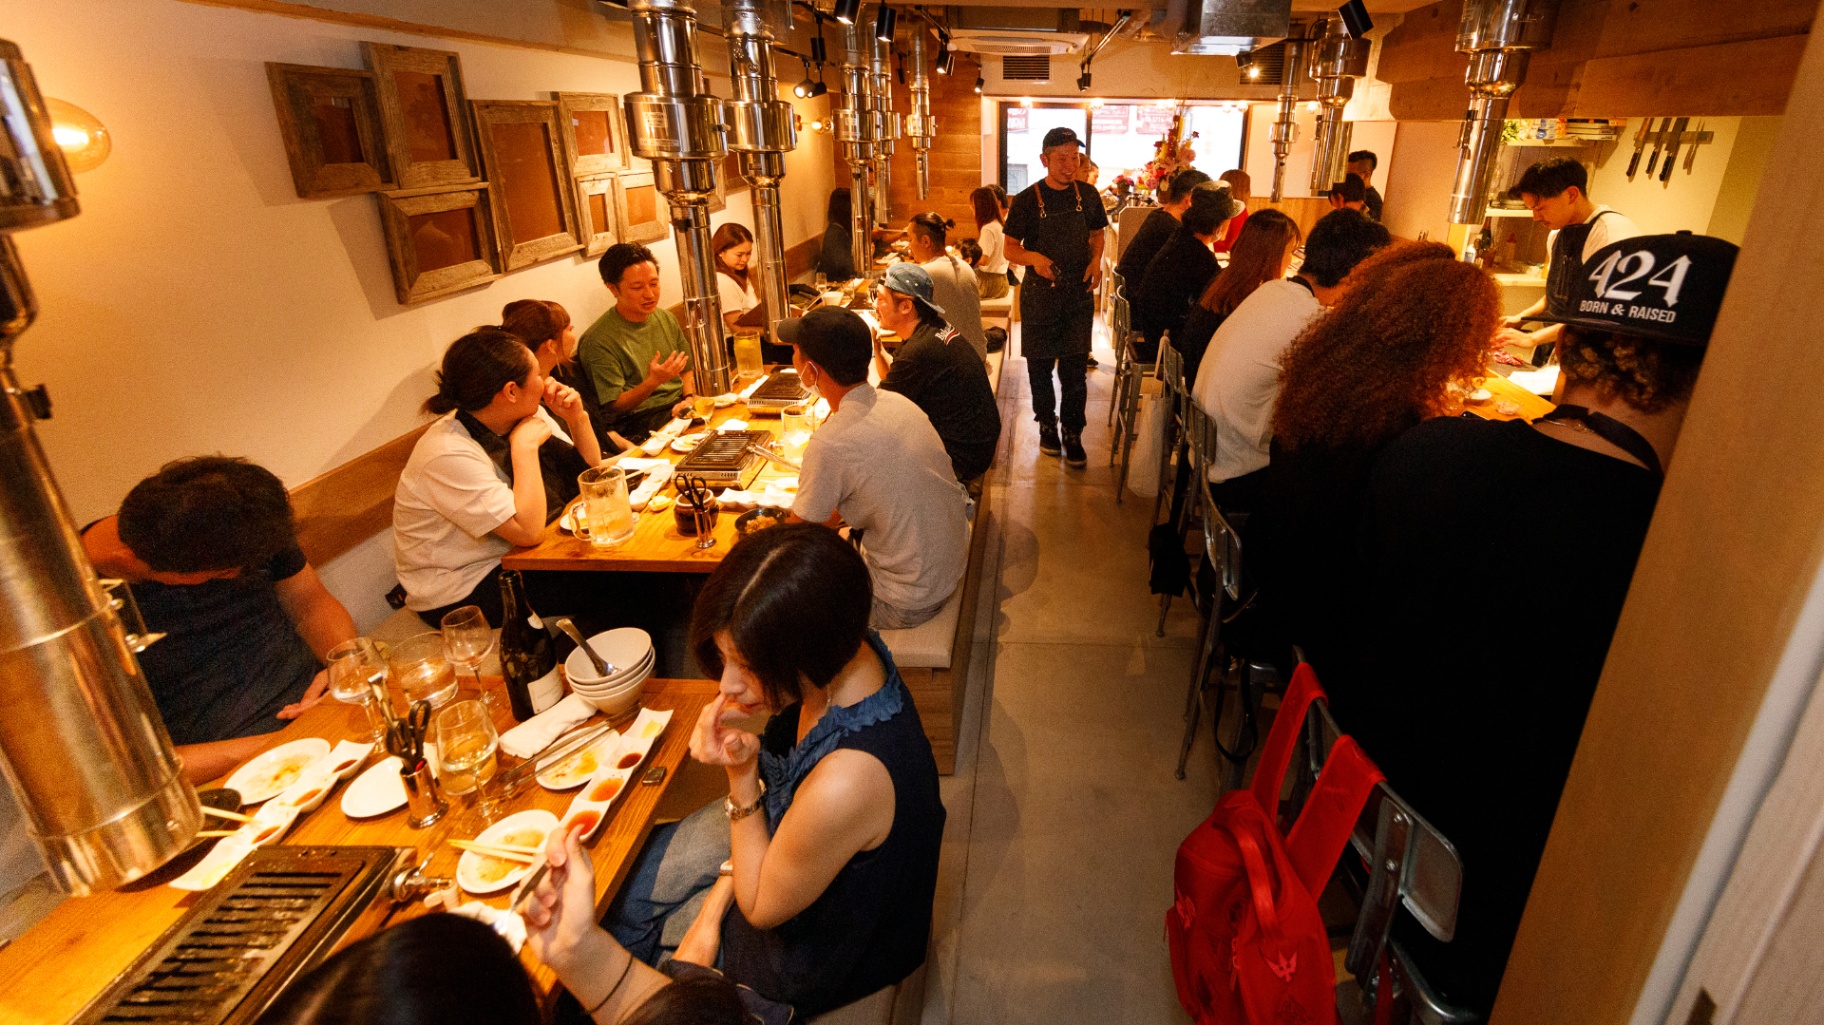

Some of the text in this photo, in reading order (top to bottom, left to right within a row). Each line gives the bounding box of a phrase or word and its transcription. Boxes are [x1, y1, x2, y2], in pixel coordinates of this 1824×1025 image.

[1588, 250, 1692, 308] 424
[1579, 300, 1677, 323] BORN & RAISED
